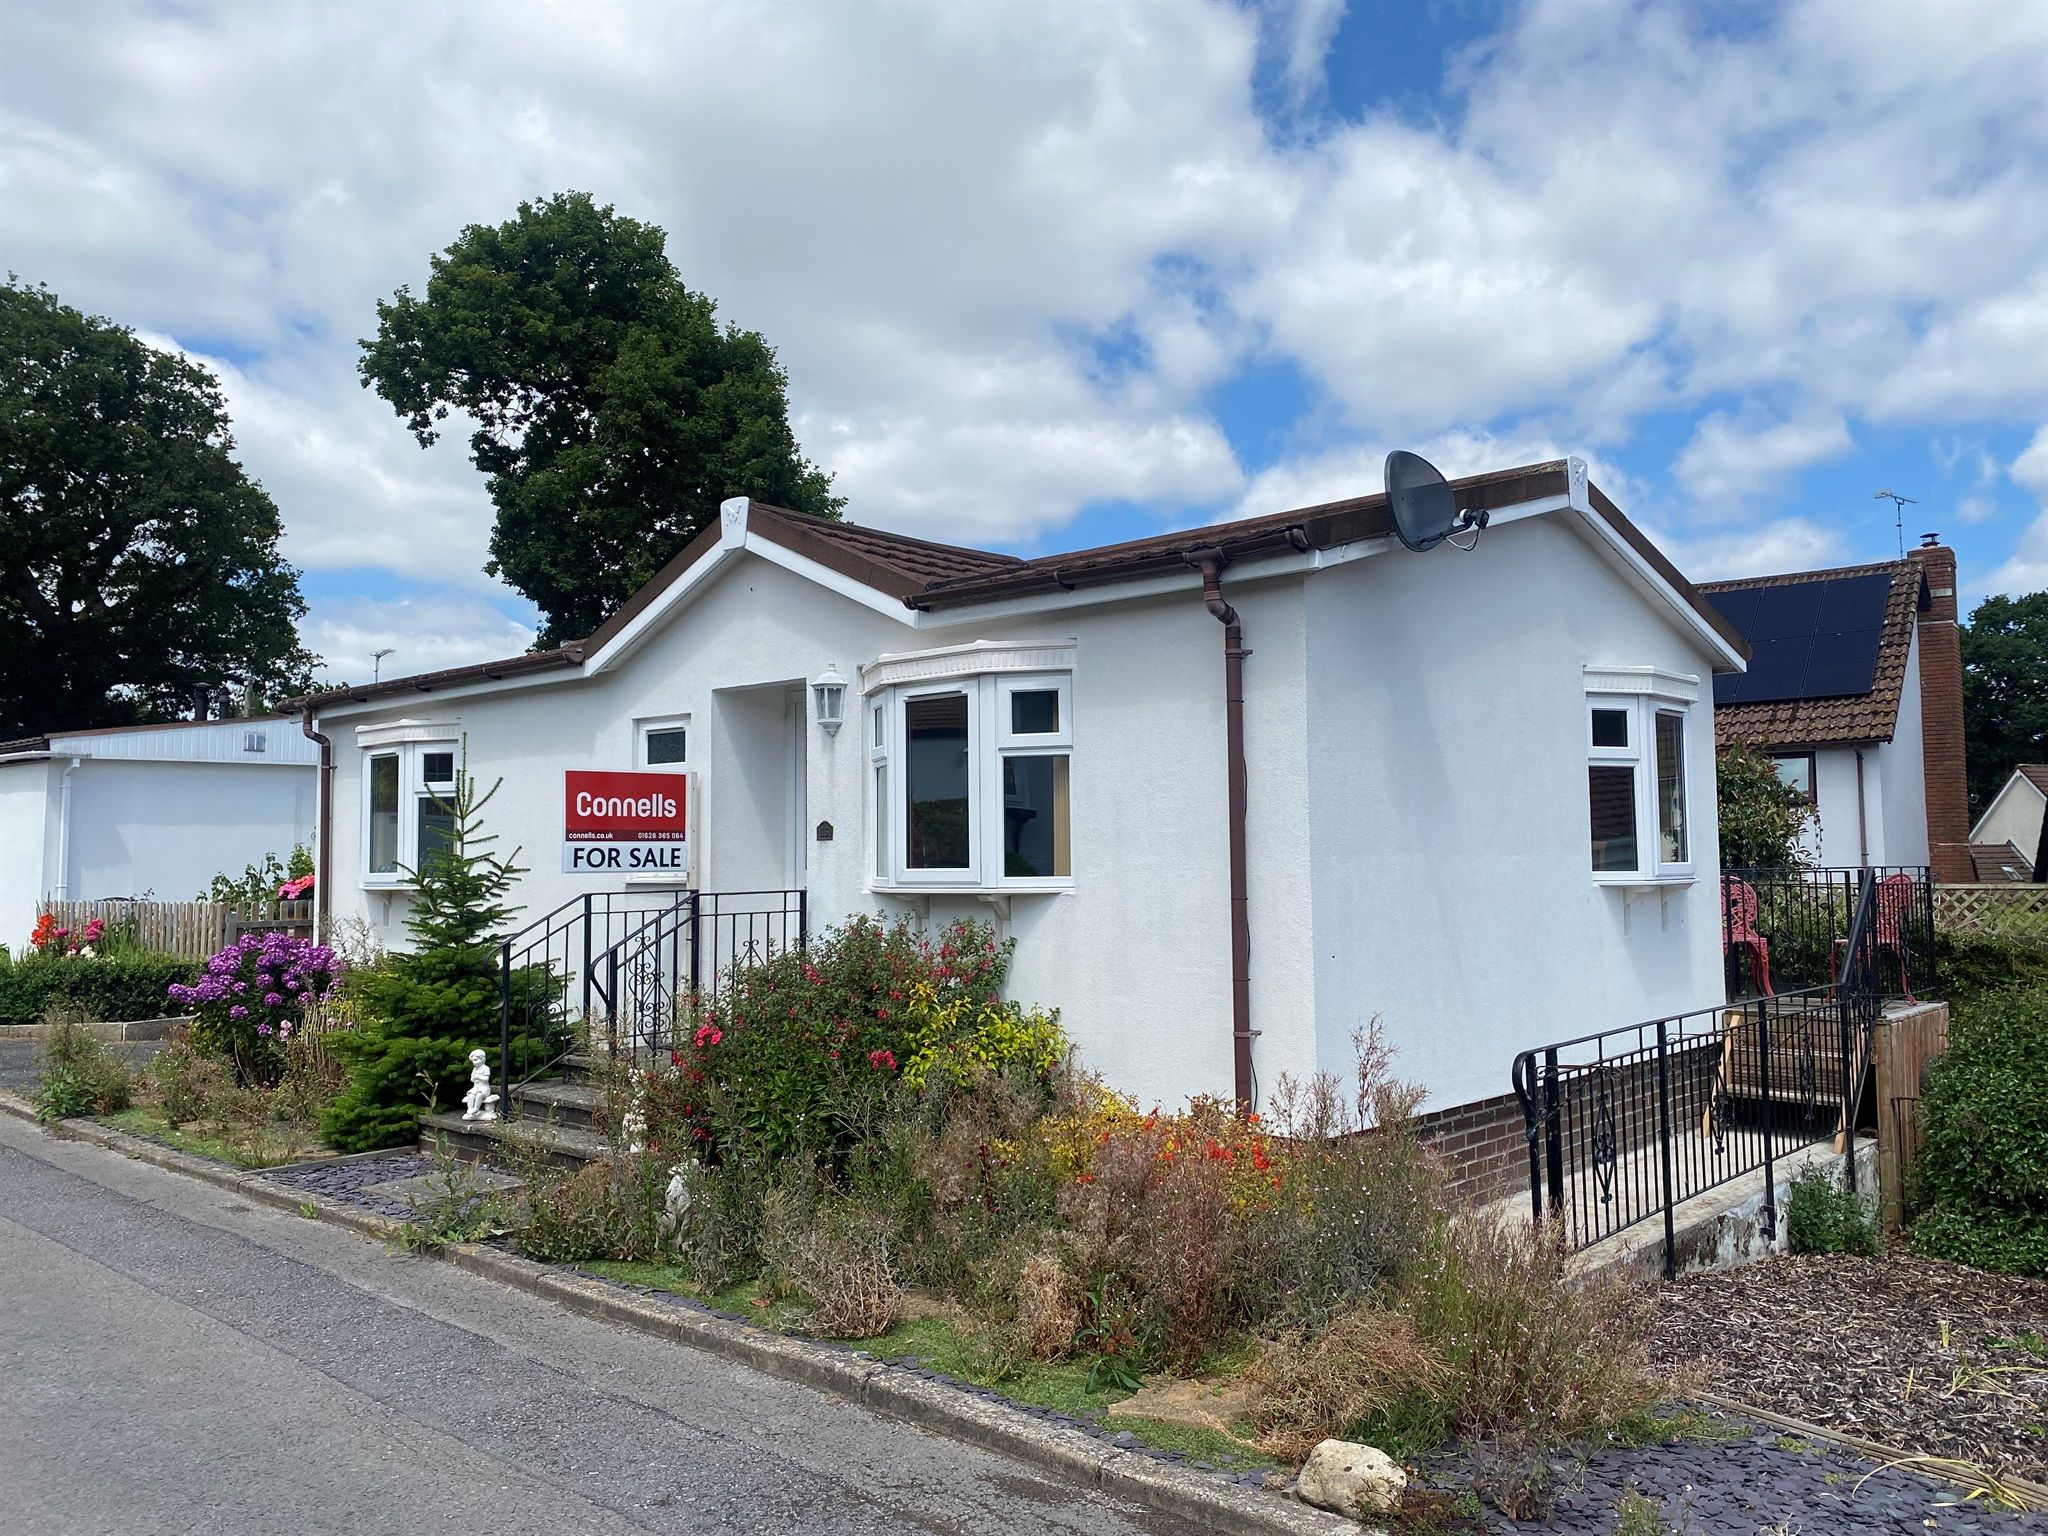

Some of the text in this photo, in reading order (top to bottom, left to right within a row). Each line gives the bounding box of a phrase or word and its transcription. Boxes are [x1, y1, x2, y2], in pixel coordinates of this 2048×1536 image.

[576, 791, 677, 818] Connells
[573, 847, 681, 868] FOR SALE
